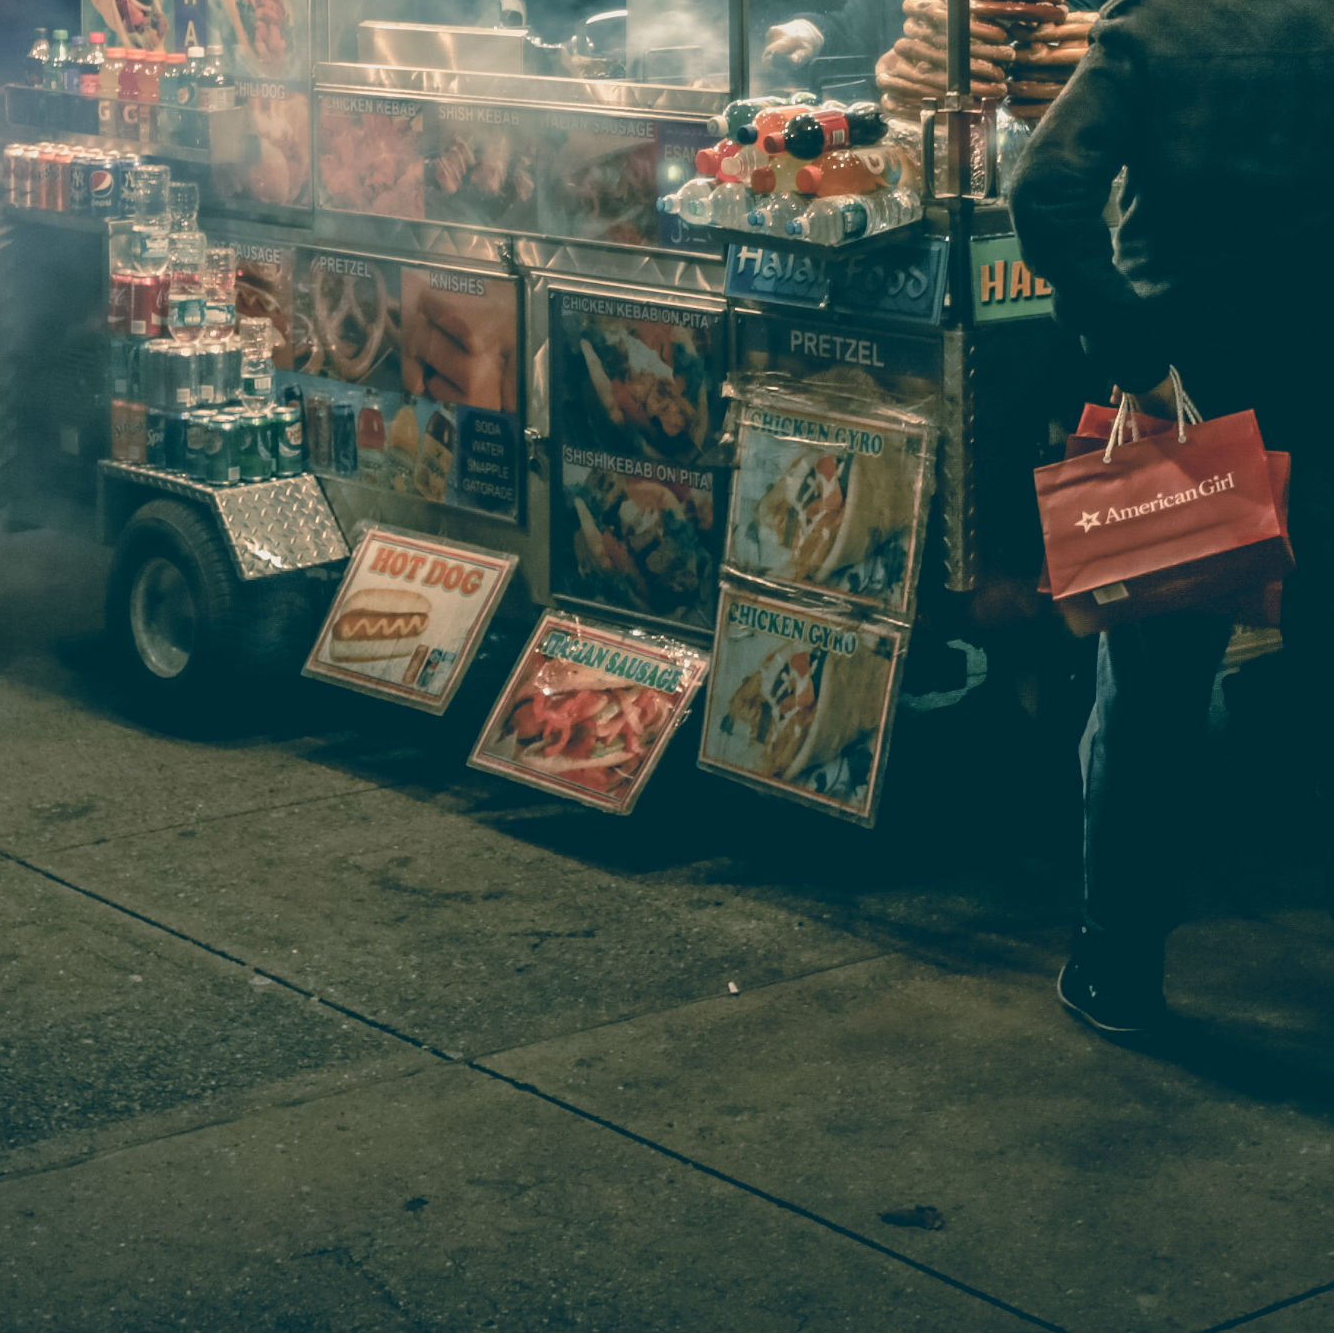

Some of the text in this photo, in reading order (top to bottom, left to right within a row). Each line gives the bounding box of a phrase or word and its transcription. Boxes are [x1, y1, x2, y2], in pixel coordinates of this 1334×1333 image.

[261, 82, 286, 100] DOG
[325, 95, 417, 117] CHICKEN KEBAB
[438, 105, 520, 126] SHISH KEBAB
[594, 118, 655, 139] SAUSAGE
[320, 256, 372, 278] PRETZEL
[735, 244, 827, 286] Halal
[429, 271, 485, 295] KNISHES
[562, 296, 614, 315] CHICKEN
[618, 303, 658, 322] KEBAB
[683, 313, 710, 330] PITA
[790, 329, 885, 368] PRETZEL
[474, 419, 501, 435] SODA
[749, 410, 884, 455] CHICKEN GYRO
[471, 440, 505, 457] WATER
[467, 459, 510, 480] SNAPPLE
[656, 465, 676, 483] ON
[679, 469, 709, 491] PITA
[462, 479, 515, 502] GATORADE
[370, 546, 484, 597] HOT DOG
[727, 602, 857, 656] CHICKEN GYRO
[604, 652, 684, 696] SAUSAGE
